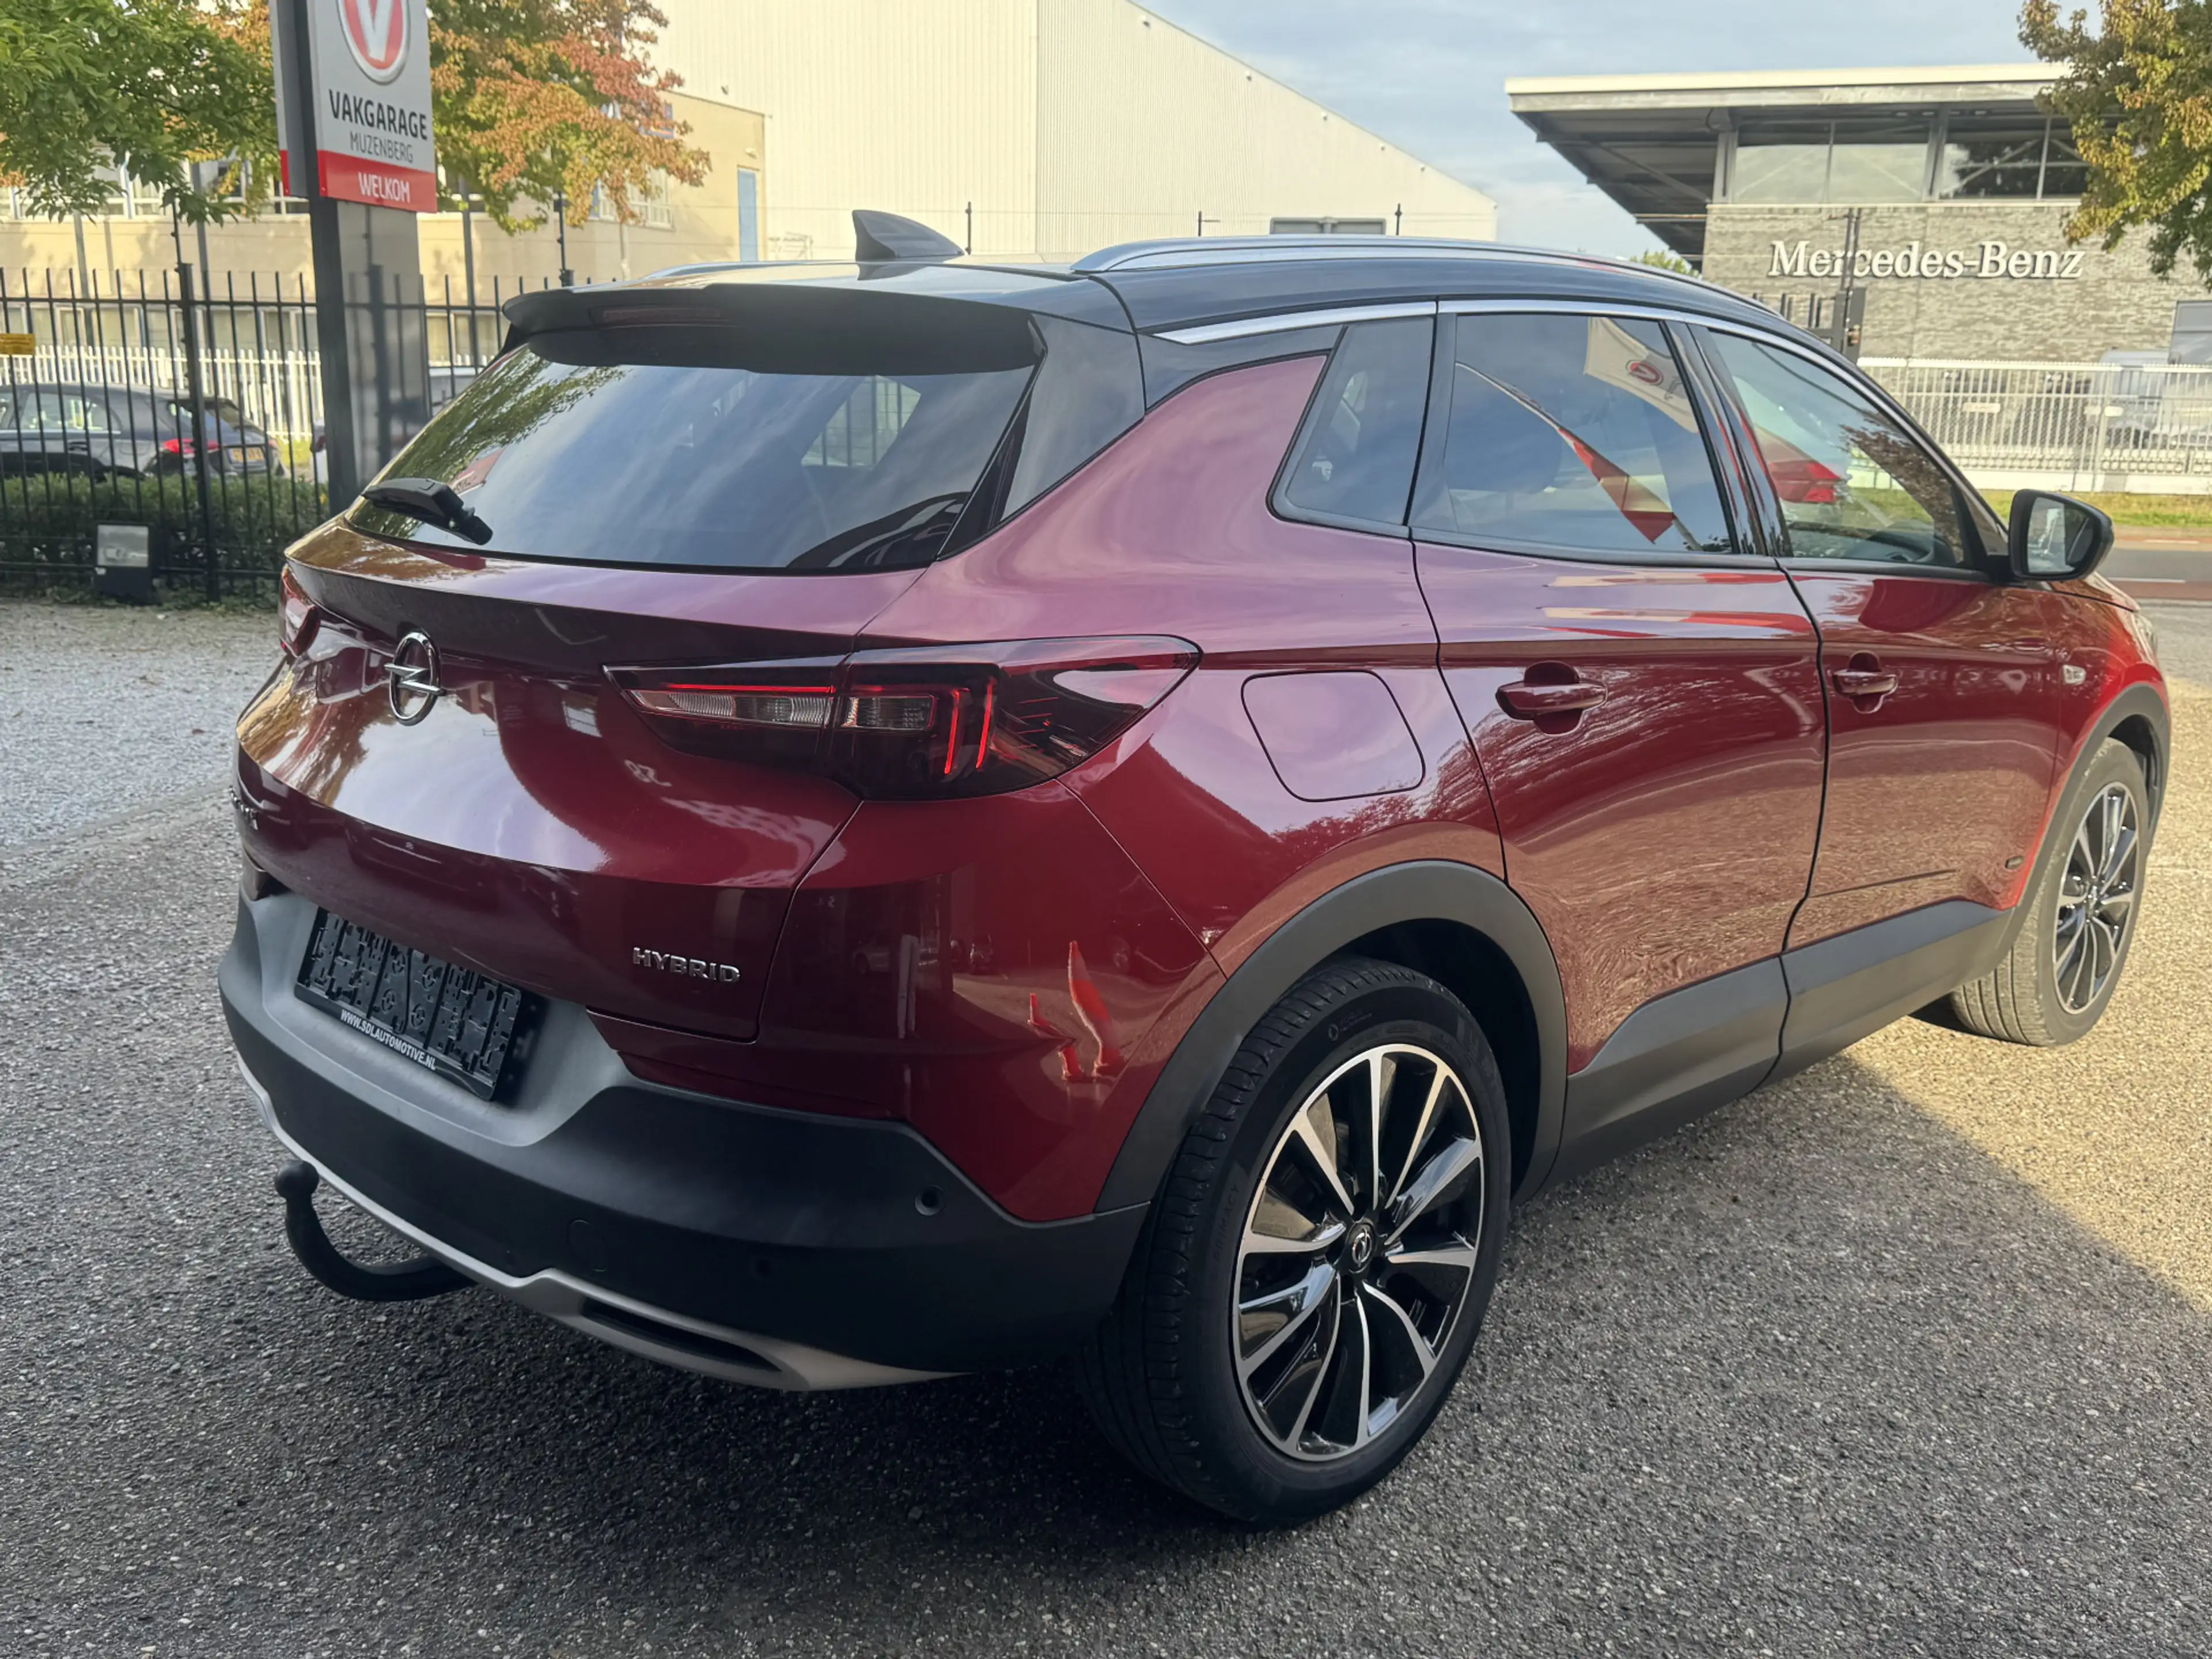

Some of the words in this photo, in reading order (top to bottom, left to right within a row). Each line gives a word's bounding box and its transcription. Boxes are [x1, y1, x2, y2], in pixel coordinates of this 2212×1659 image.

[329, 89, 428, 140] VAKGARAGE
[350, 131, 414, 164] MUZENBERG
[358, 172, 411, 203] WELKOM
[1768, 240, 2086, 279] Mercedes-Benz
[632, 946, 741, 982] HYBRID
[340, 1009, 437, 1070] WWW.SDLAUTOMOTIVE.NL
